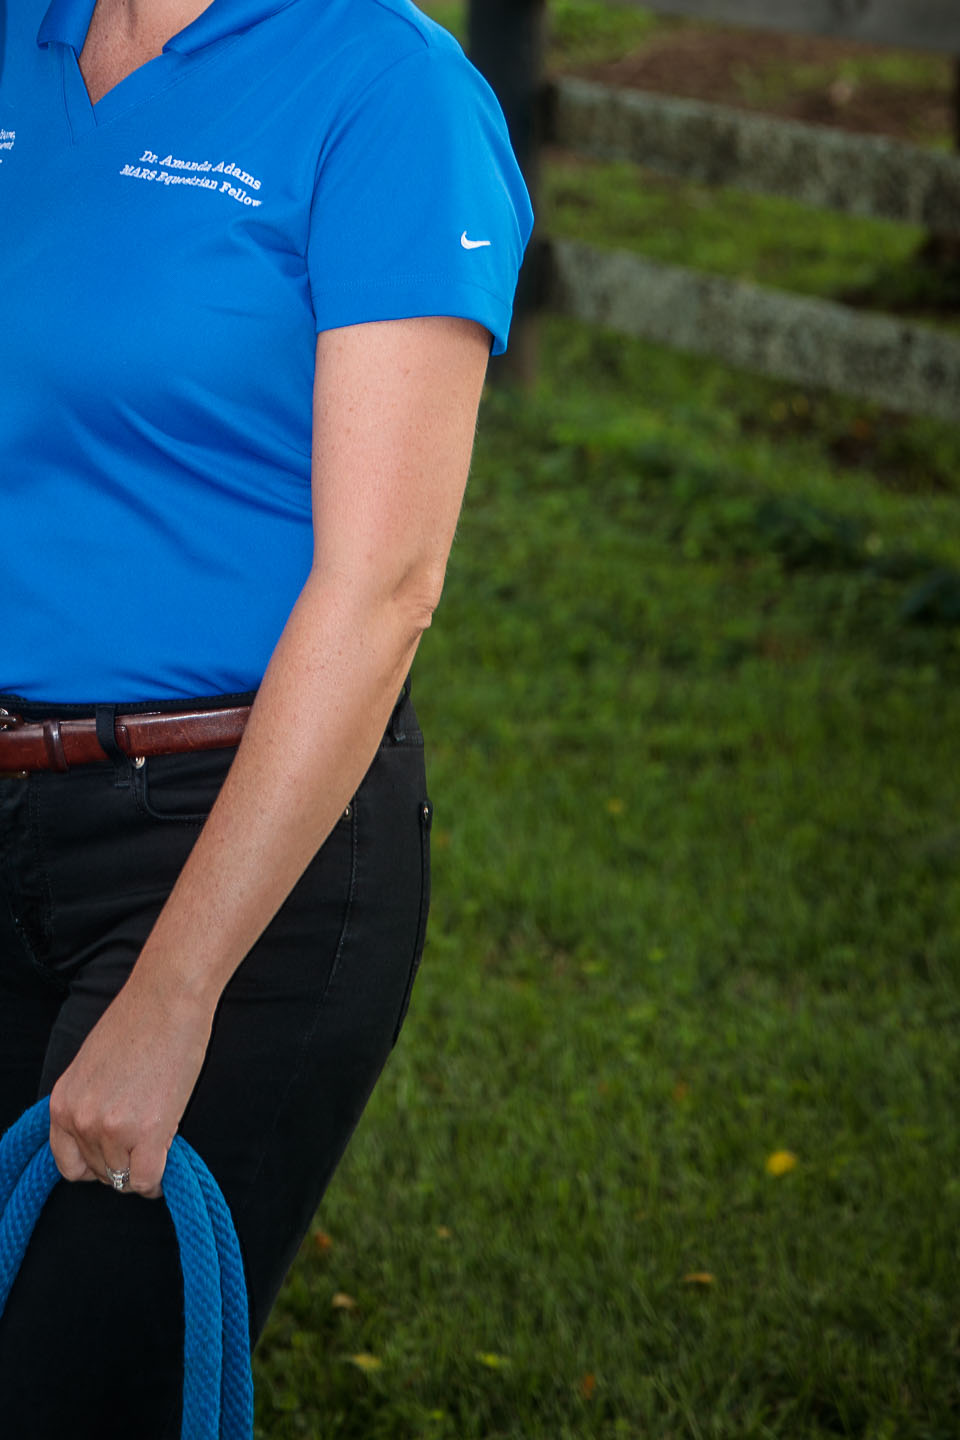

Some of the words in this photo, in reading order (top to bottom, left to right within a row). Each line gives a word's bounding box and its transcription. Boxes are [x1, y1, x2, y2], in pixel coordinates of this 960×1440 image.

[120, 164, 157, 181] MARS
[156, 171, 218, 189] Equestrian
[219, 181, 263, 207] Fellow
[139, 150, 158, 163] Dr.
[159, 155, 212, 172] Amanda
[212, 161, 262, 190] Adams
